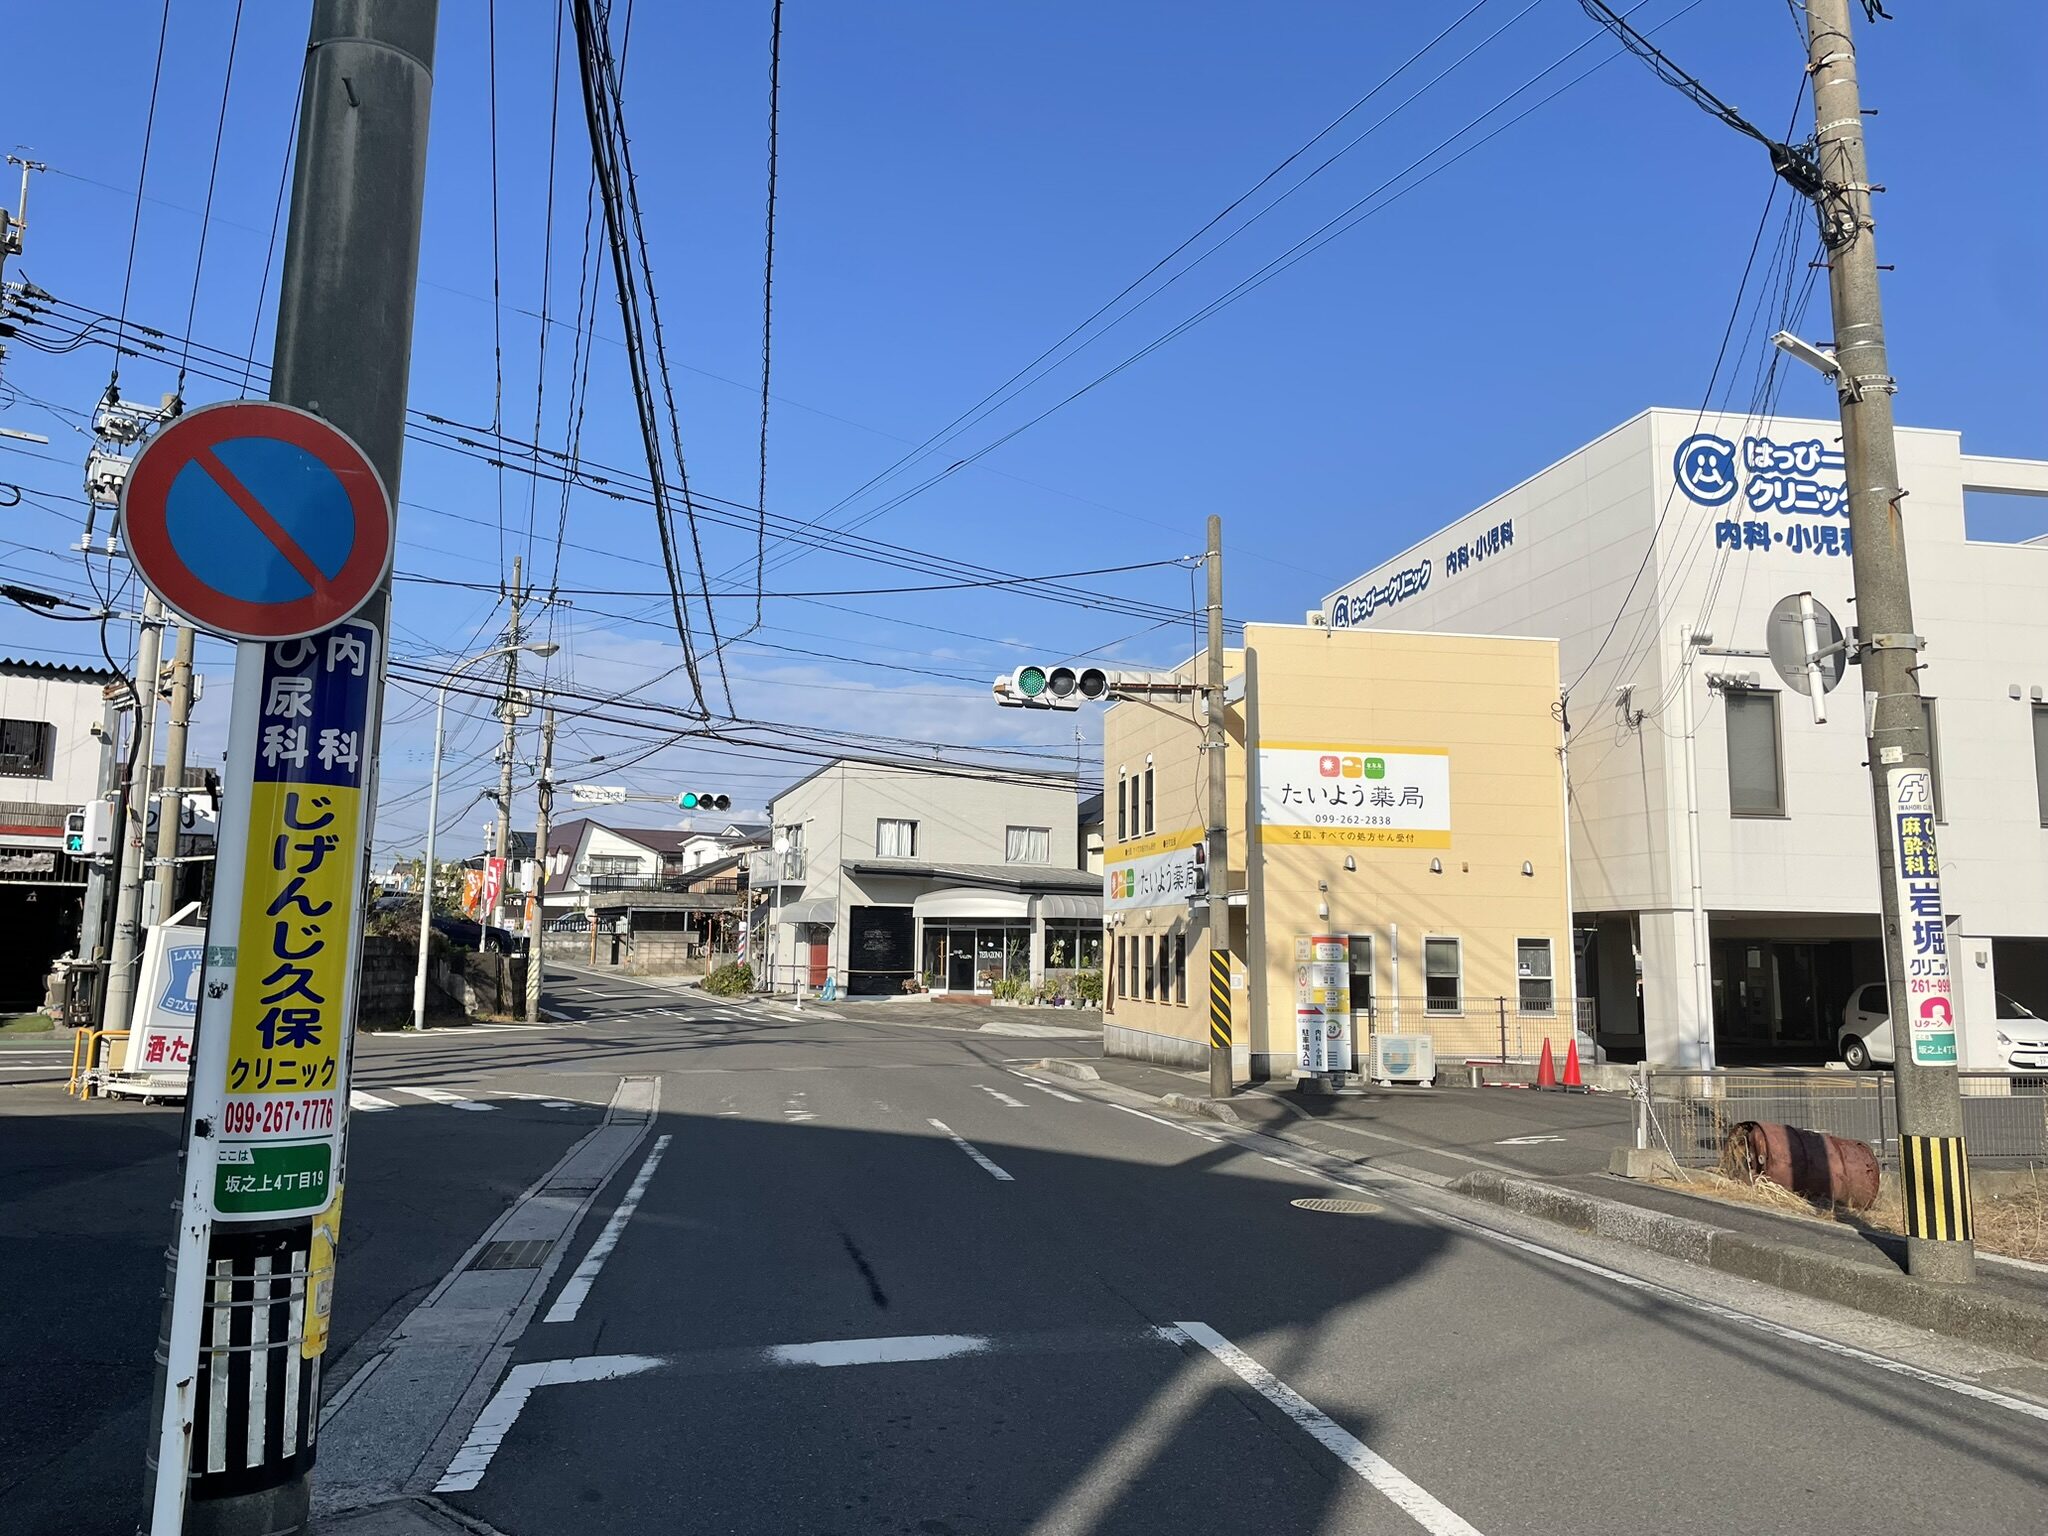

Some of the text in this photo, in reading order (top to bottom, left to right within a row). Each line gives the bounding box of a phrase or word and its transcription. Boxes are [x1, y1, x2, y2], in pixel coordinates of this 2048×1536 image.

[1744, 437, 1845, 475] はっぴー
[1446, 519, 1514, 578] 内科・小児科
[1281, 783, 1424, 809] たいよう薬局
[1315, 814, 1391, 825] 099-262-2838
[1293, 830, 1414, 843] 全国、すべての処方せん受付
[1901, 816, 1926, 876] 麻酔科
[255, 792, 340, 1050] じげんじ久保
[231, 1055, 335, 1090] クリニック
[218, 1149, 249, 1162] ここは
[225, 1170, 324, 1194] 坂之上4丁目19
